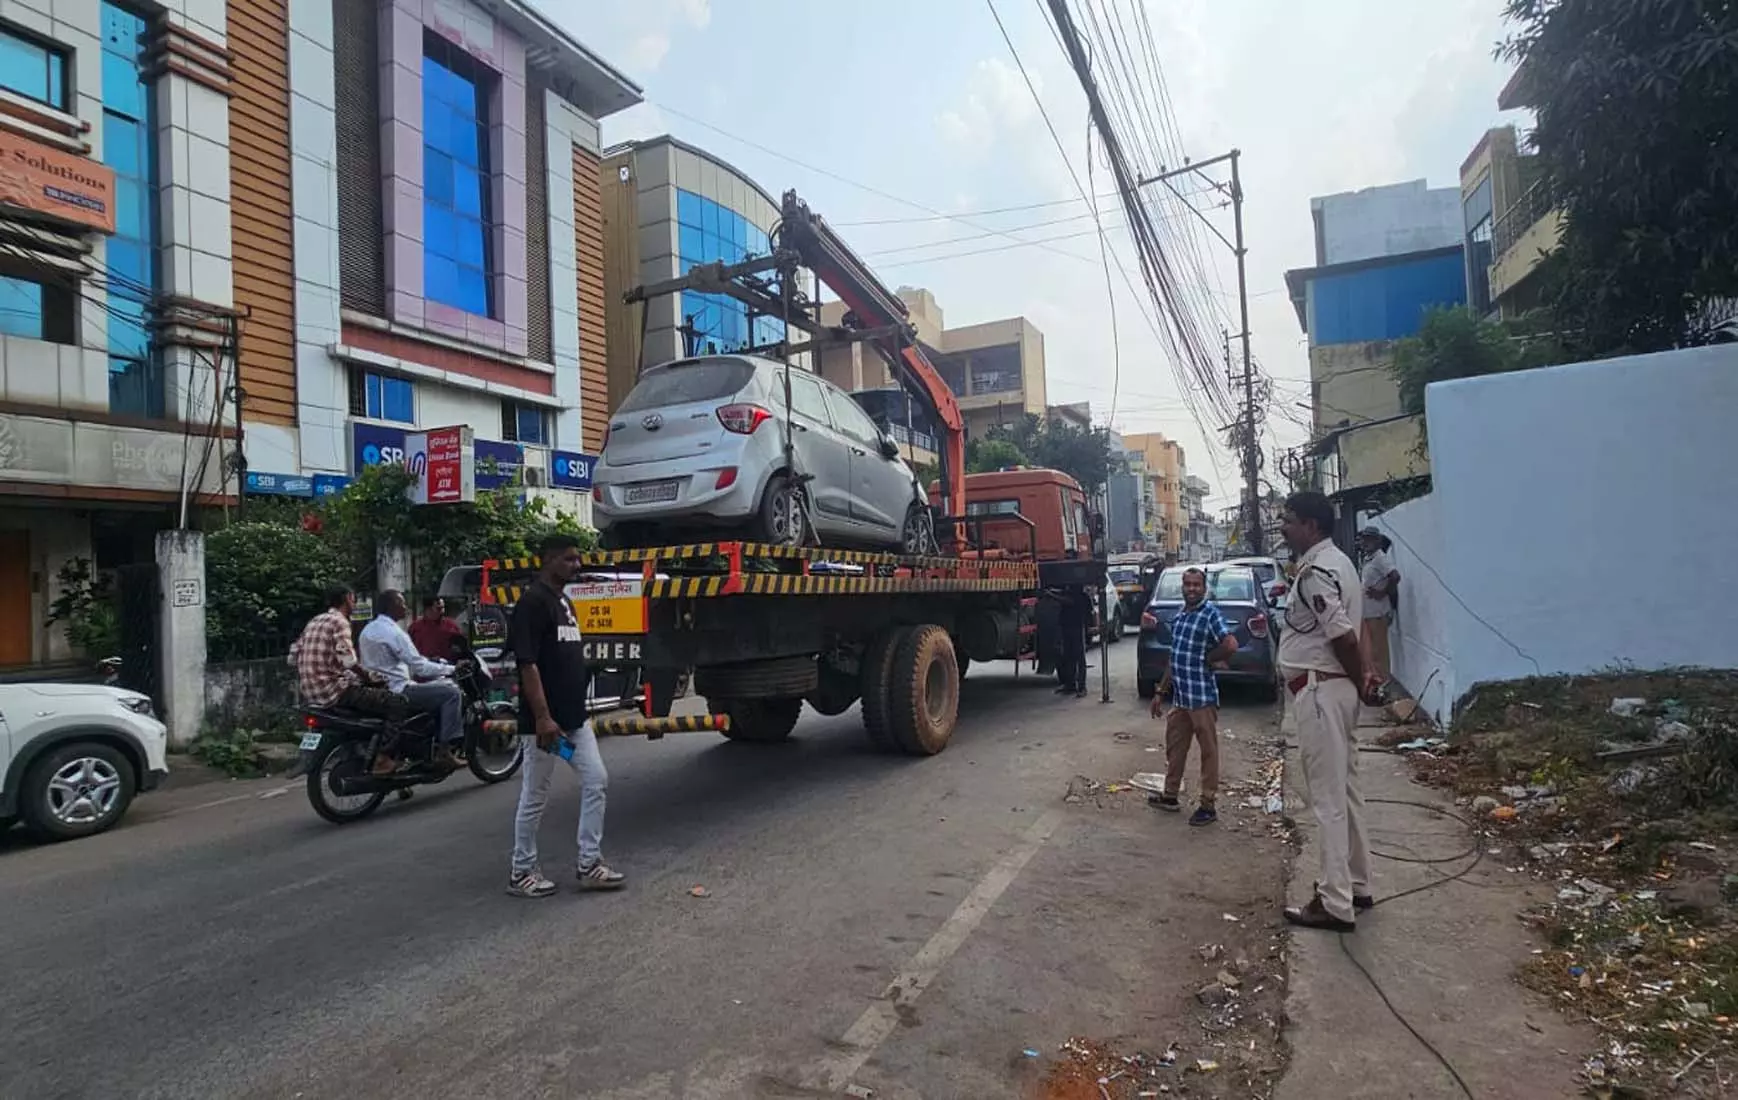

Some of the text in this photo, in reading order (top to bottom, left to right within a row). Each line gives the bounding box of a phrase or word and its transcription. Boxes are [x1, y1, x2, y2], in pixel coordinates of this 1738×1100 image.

[13, 150, 107, 191] Solutions
[380, 446, 405, 466] SB
[568, 459, 589, 479] SBI
[257, 475, 275, 487] SBI
[582, 643, 641, 660] CHER
